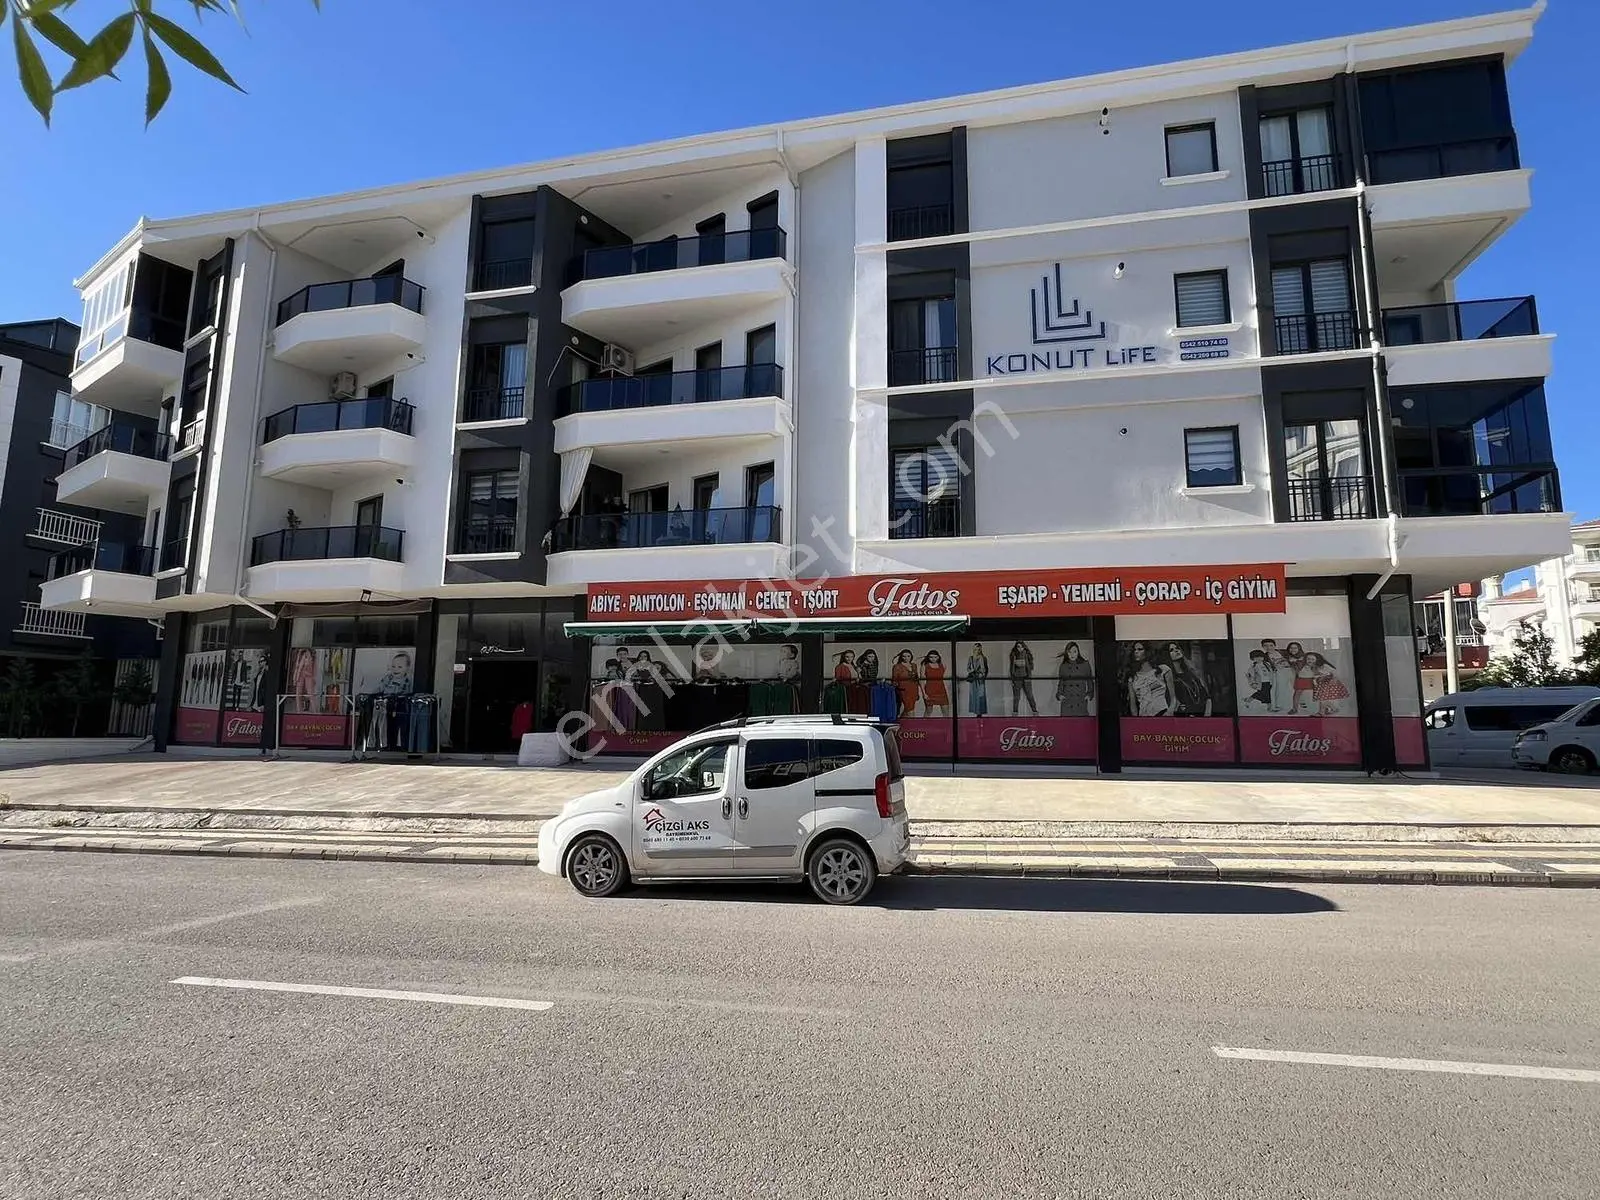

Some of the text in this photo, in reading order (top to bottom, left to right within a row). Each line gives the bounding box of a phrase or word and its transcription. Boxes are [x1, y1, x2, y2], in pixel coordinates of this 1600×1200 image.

[987, 348, 1094, 375] KONUT
[590, 590, 621, 613] ABİYE
[629, 593, 685, 612] PANTOLON
[694, 591, 746, 616] EŞOFMAN
[755, 590, 792, 610] CEKET
[867, 577, 960, 617] Fatoş
[998, 575, 1276, 609] EŞARP YEMENİ ÇORAP İÇ GİYİM
[1000, 726, 1055, 752] Fatoş
[1268, 729, 1332, 756] Fatoş
[654, 820, 710, 834] ÇİZGİ AKS
